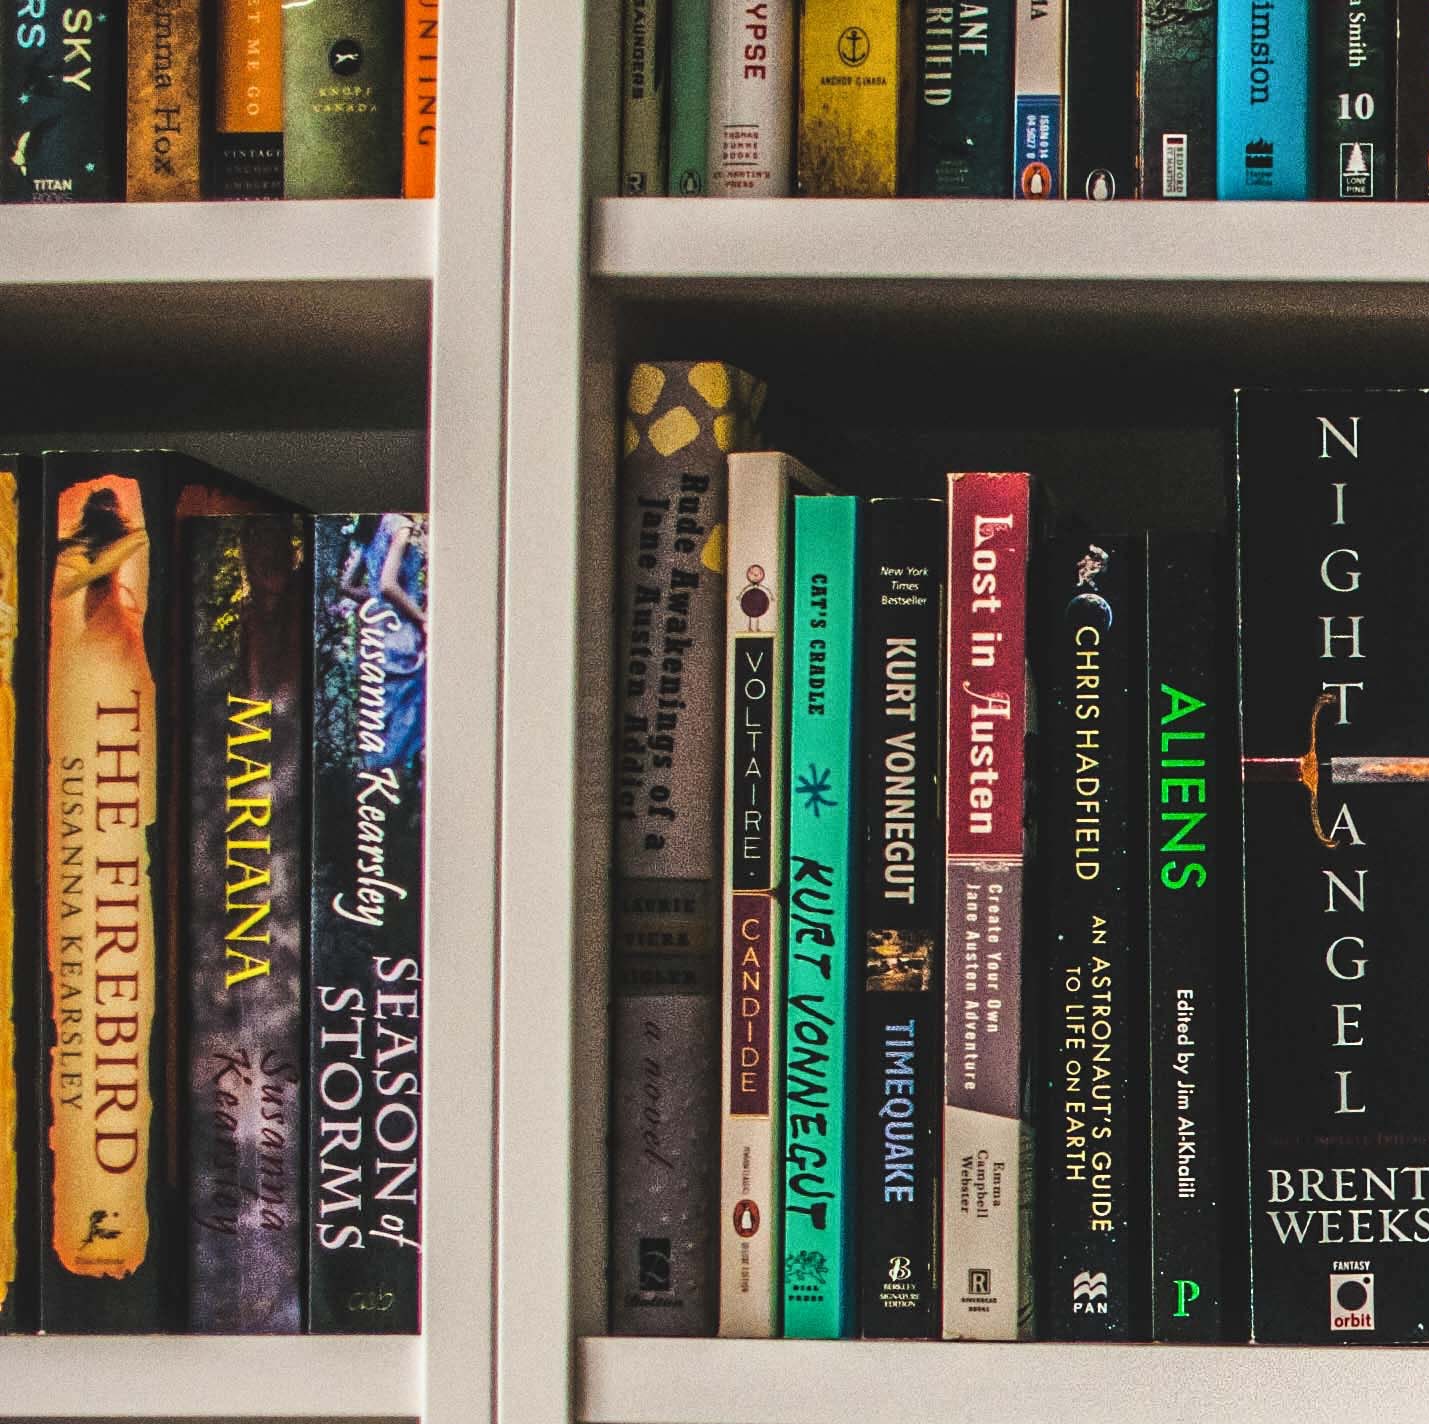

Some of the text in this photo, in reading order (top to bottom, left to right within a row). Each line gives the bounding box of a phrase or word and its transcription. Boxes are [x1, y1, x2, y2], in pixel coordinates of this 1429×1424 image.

[62, 8, 92, 91] SKY
[1337, 94, 1374, 120] 10
[1348, 11, 1366, 67] Smith
[33, 179, 72, 190] TITAN
[1346, 177, 1367, 185] LONE
[880, 566, 929, 576] New York
[881, 595, 927, 605] Bestseller
[892, 581, 919, 590] Times
[808, 639, 827, 716] CRADLE
[962, 514, 1013, 834] Lost in Austen
[1075, 626, 1100, 881] CHRIS HADFIELD
[224, 692, 272, 989] MARIANA
[884, 637, 917, 905] KURT VONNEGUT
[1159, 683, 1207, 890] ALIENS
[60, 757, 84, 1110] SUSANNA KEARSLEY
[94, 690, 140, 1175] THE FIREBIRD
[741, 918, 760, 1093] CANDIDE
[963, 884, 980, 1091] Jane Austen Adventure
[985, 884, 1002, 1034] Create Your Own
[317, 987, 366, 1250] STORMS
[373, 956, 421, 1205] SEASON
[879, 1019, 916, 1203] TIMEQUAKE
[1065, 966, 1087, 1181] TO LIFE ON EARTH
[1092, 955, 1113, 1232] ASTRONAUT'S GUIDE
[1176, 989, 1196, 1199] Edited Jim Al-Khalili
[960, 1155, 971, 1215] Webster
[975, 1149, 989, 1219] Campbell
[1073, 1302, 1108, 1314] PAN
[1333, 1261, 1370, 1271] FANTASY
[1335, 1312, 1372, 1328] orbit
